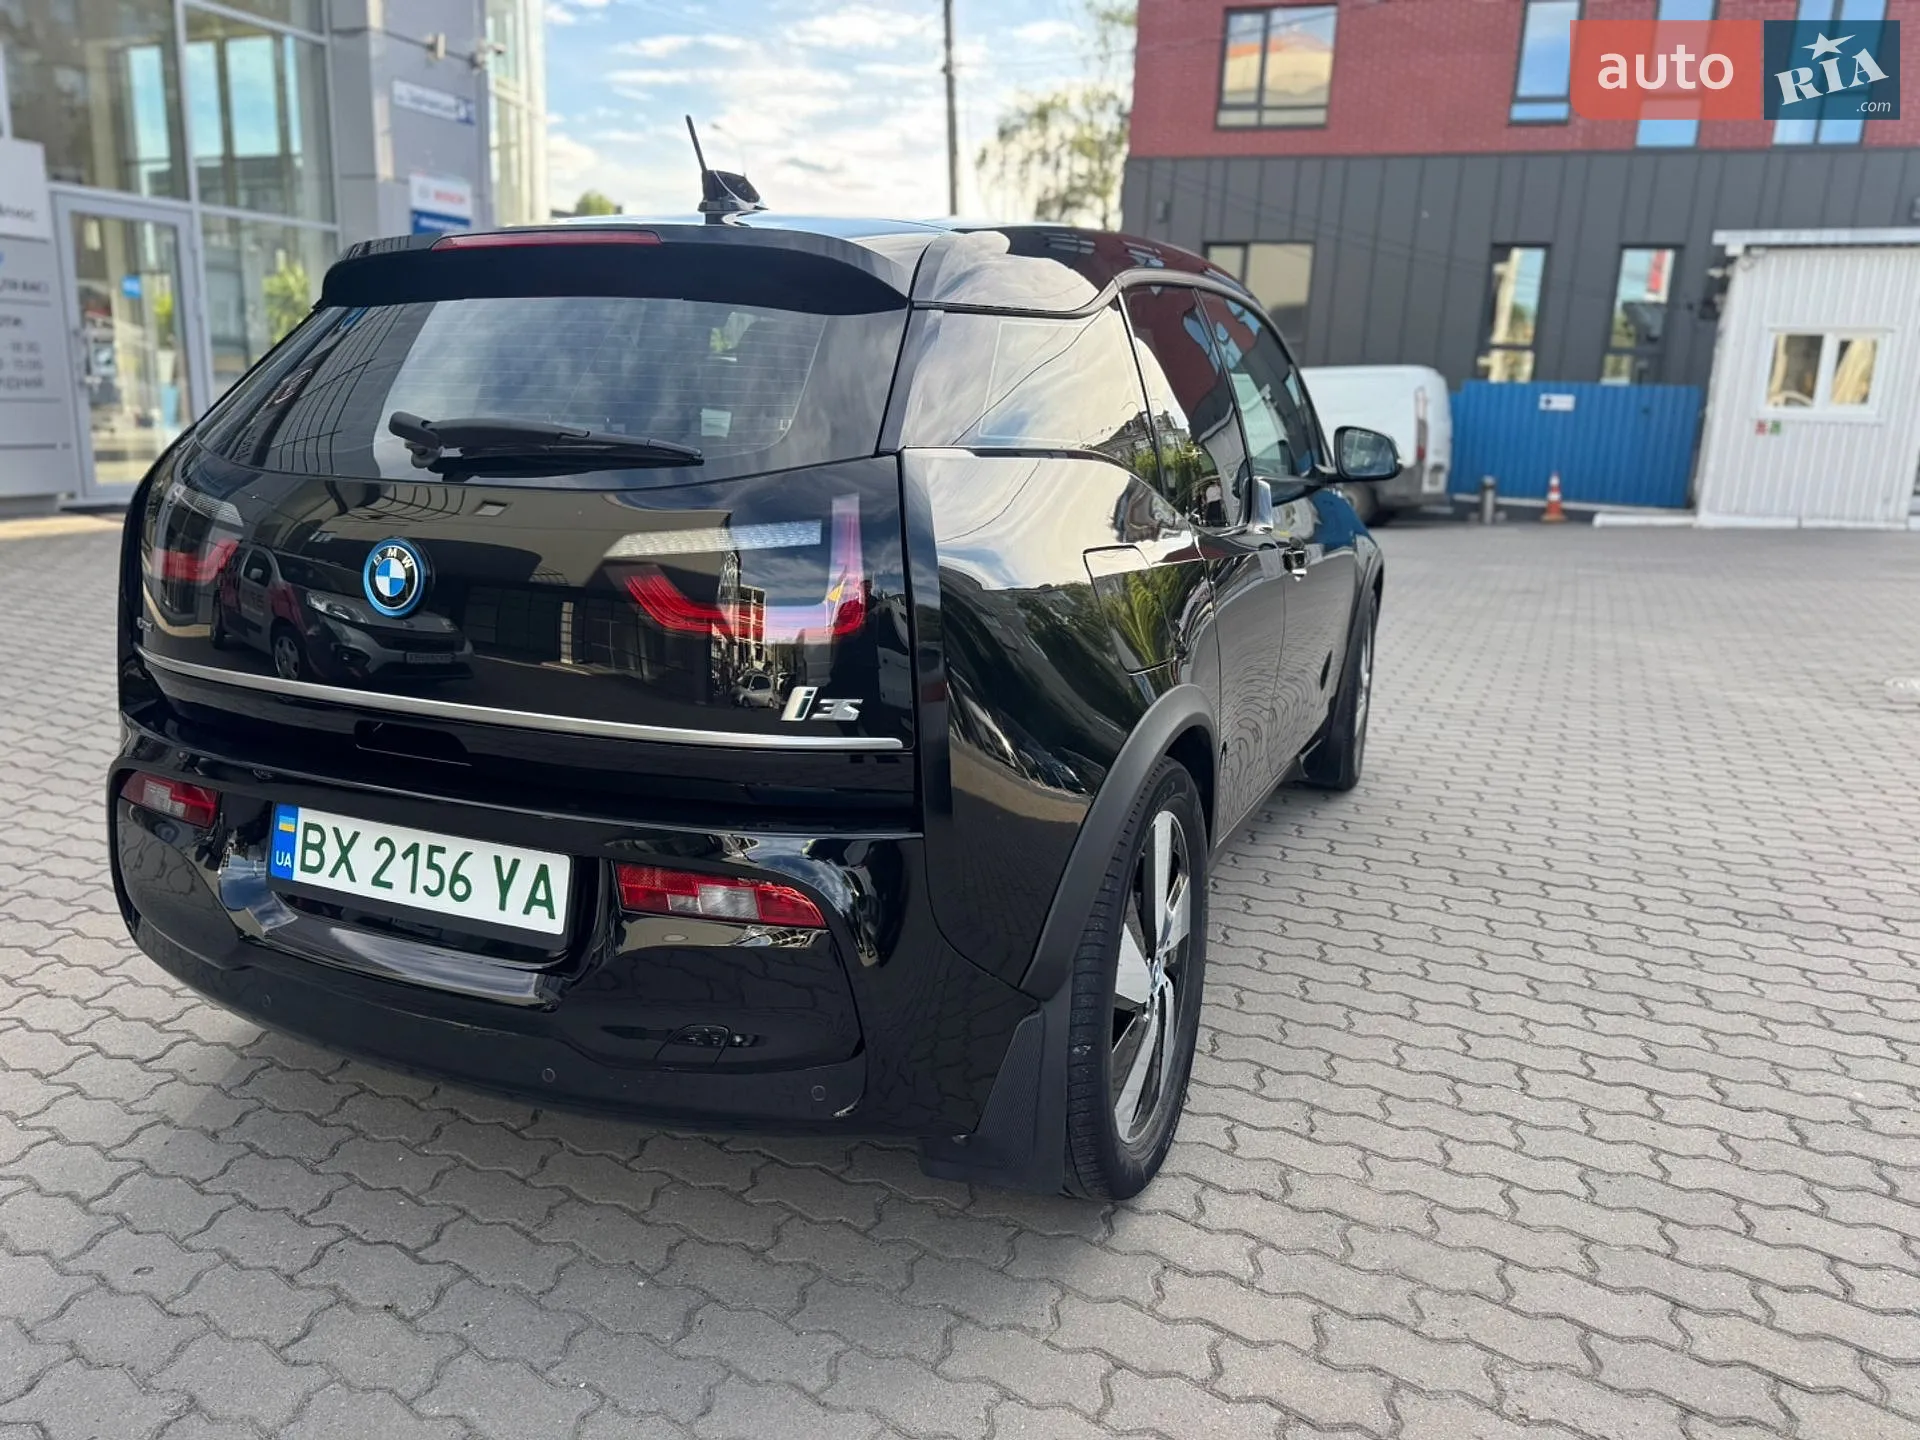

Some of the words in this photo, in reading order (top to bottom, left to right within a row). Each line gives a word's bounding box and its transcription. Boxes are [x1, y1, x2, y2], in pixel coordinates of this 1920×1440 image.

[373, 547, 414, 569] BMW
[276, 851, 292, 868] UA
[300, 822, 361, 883] BX
[371, 836, 473, 903] 2156
[493, 854, 556, 920] YA
